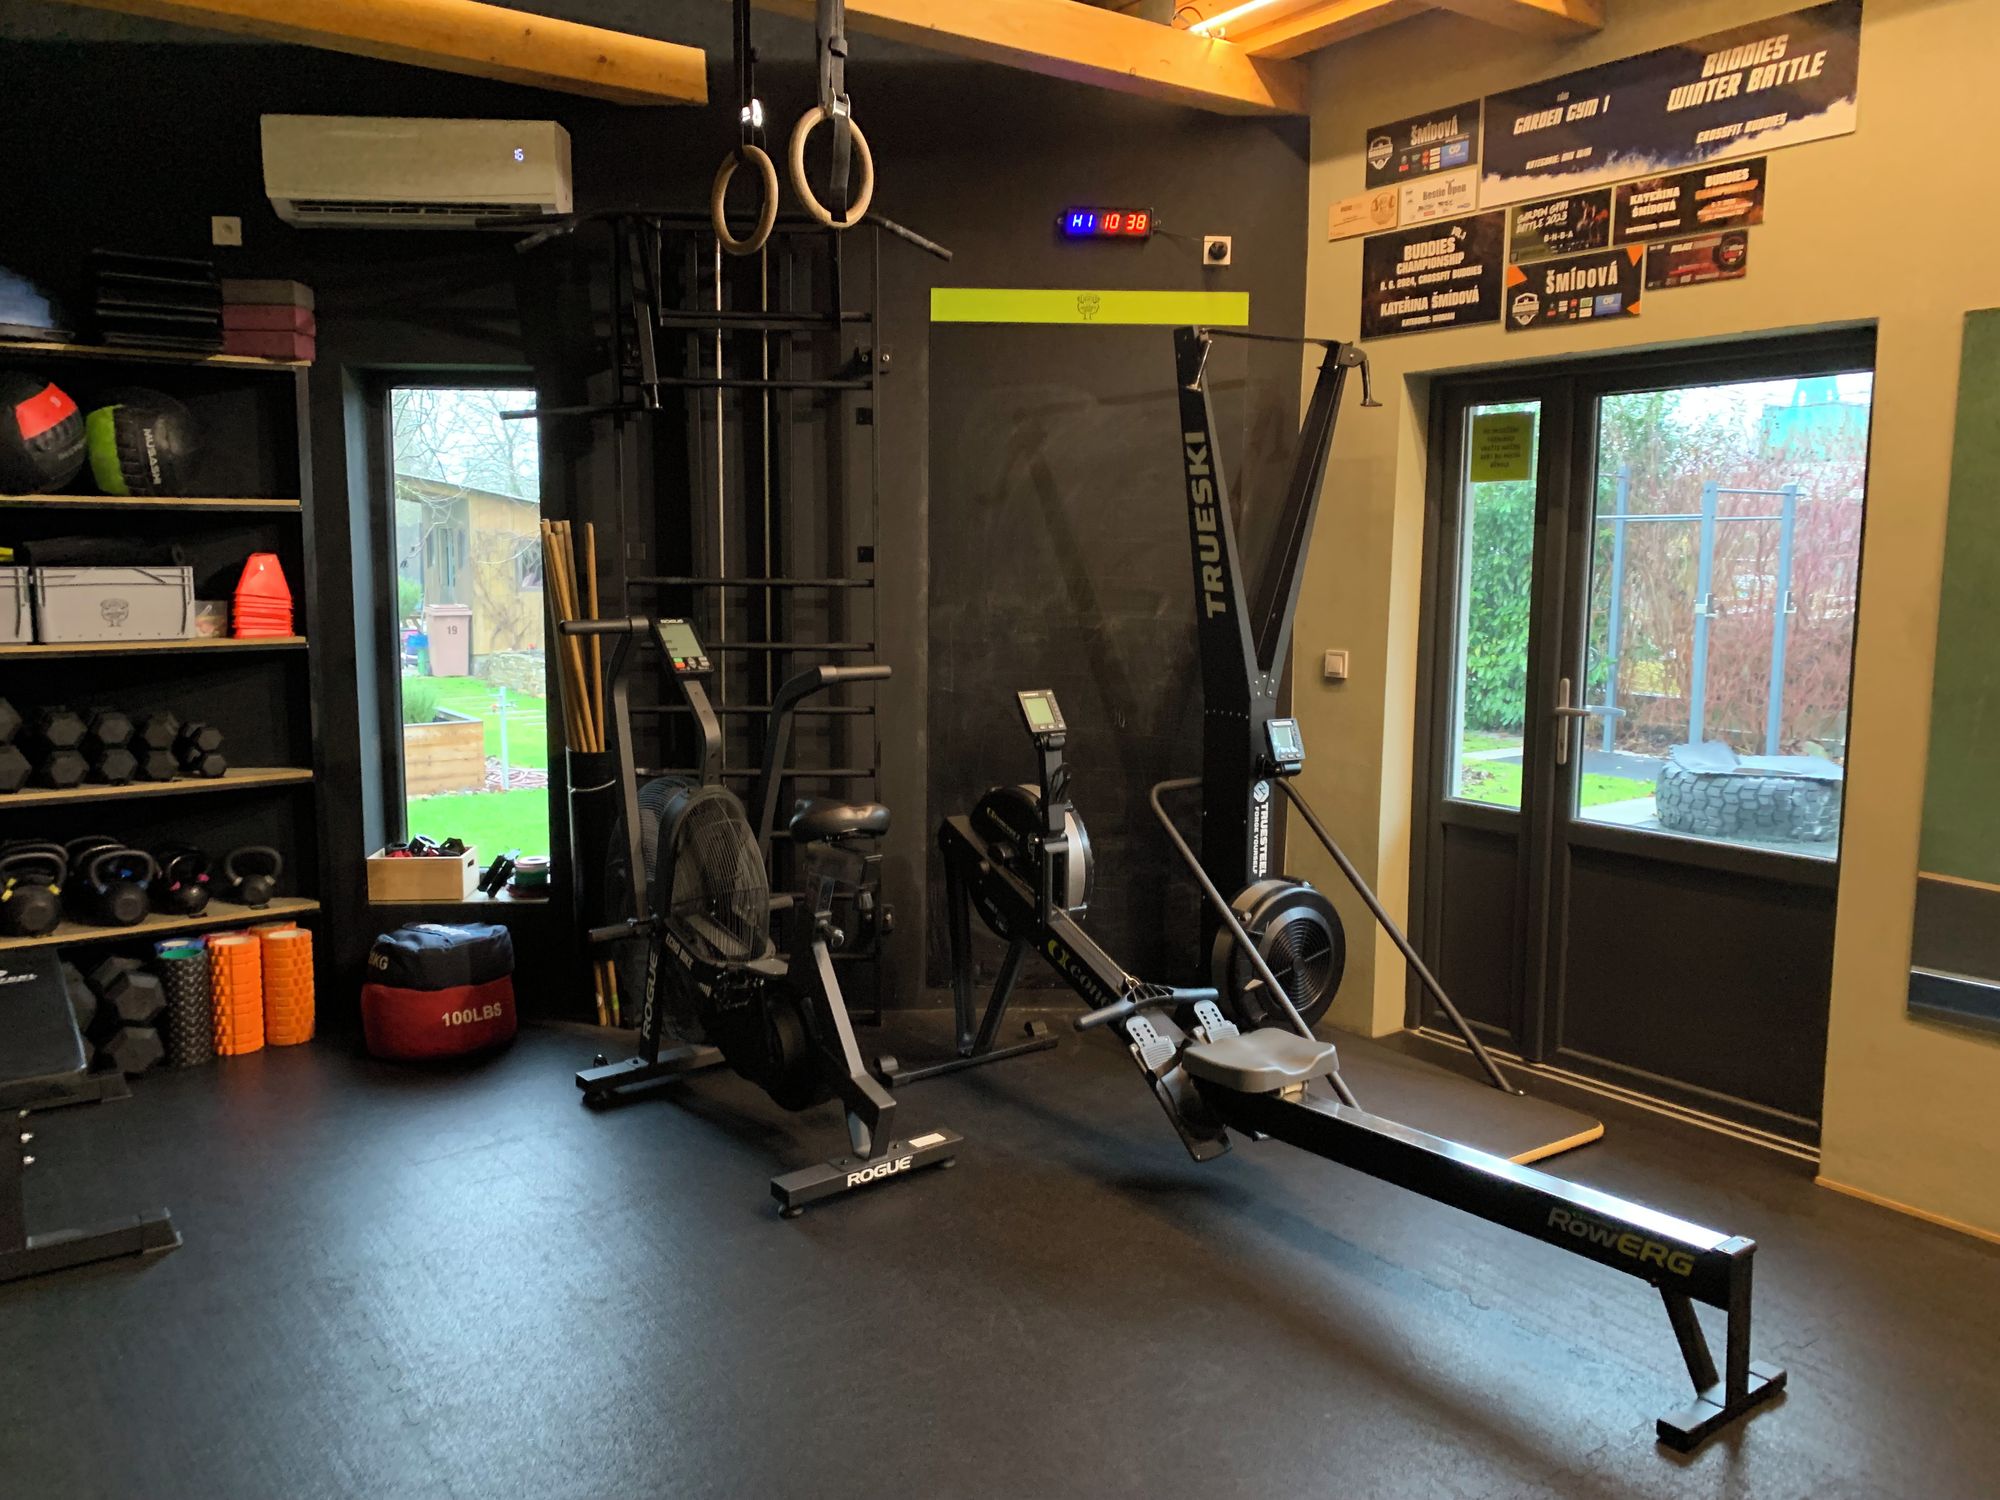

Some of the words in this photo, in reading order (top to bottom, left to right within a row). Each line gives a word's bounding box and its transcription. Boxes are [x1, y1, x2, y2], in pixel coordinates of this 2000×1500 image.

[1701, 34, 1789, 78] BUDDIES
[1667, 72, 1743, 111] WINTER
[1746, 50, 1828, 93] BATTLE
[1410, 114, 1458, 146] ŠMÍDOVÁ
[1513, 107, 1564, 135] GARDEN
[1566, 98, 1599, 122] GYM
[1696, 123, 1744, 144] CROSSFIT
[1744, 112, 1788, 133] BUDDIES
[1630, 186, 1680, 206] KATEŘINA
[1103, 213, 1121, 230] 10
[1126, 213, 1147, 230] 38
[1396, 251, 1465, 275] CHAMPIONSHIP
[1404, 236, 1456, 261] BUDDIES
[1418, 270, 1452, 285] CROSSFIT
[1545, 260, 1618, 294] ŠMÍDOVÁ
[1380, 295, 1429, 317] KATEŘINA
[1431, 284, 1480, 309] ŠMÍDOVÁ
[1184, 432, 1227, 619] TRUESKI
[447, 624, 459, 635] 19
[1259, 801, 1269, 878] TRUESTEEL
[642, 950, 659, 1041] ROGUE
[441, 1002, 502, 1027] 100LBS
[847, 1155, 913, 1187] ROGUE
